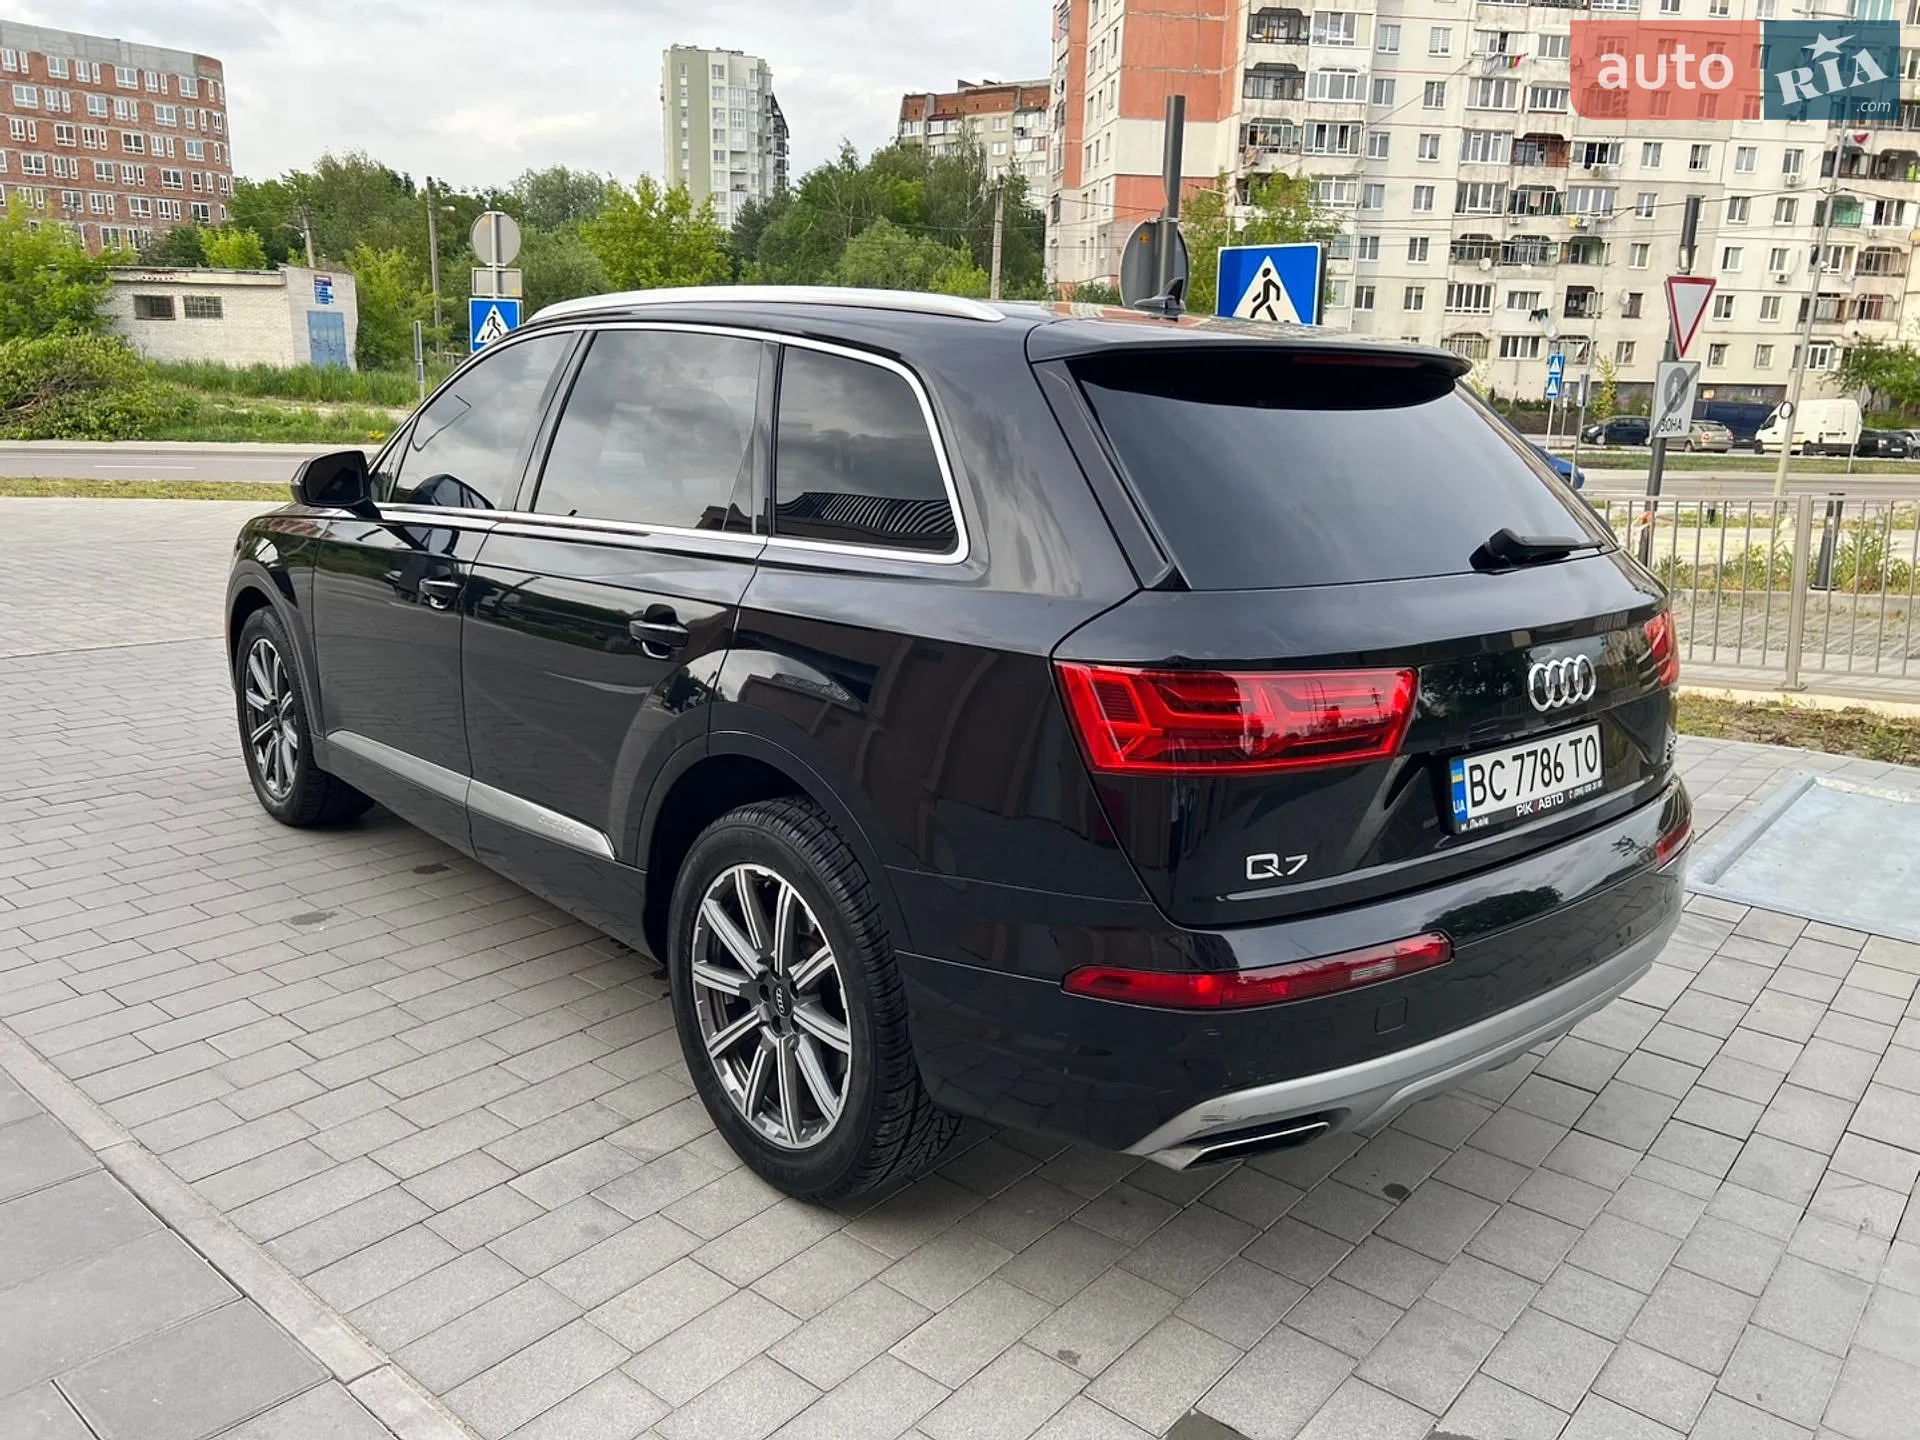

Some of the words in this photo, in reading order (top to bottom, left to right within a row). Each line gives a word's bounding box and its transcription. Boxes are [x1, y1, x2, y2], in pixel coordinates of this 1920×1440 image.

[1660, 417, 1683, 432] ЗОНА
[1468, 759, 1507, 808] BC
[1512, 742, 1564, 797] 7786
[1569, 734, 1598, 778] TO
[1453, 800, 1466, 814] UA
[1246, 853, 1308, 880] Q7
